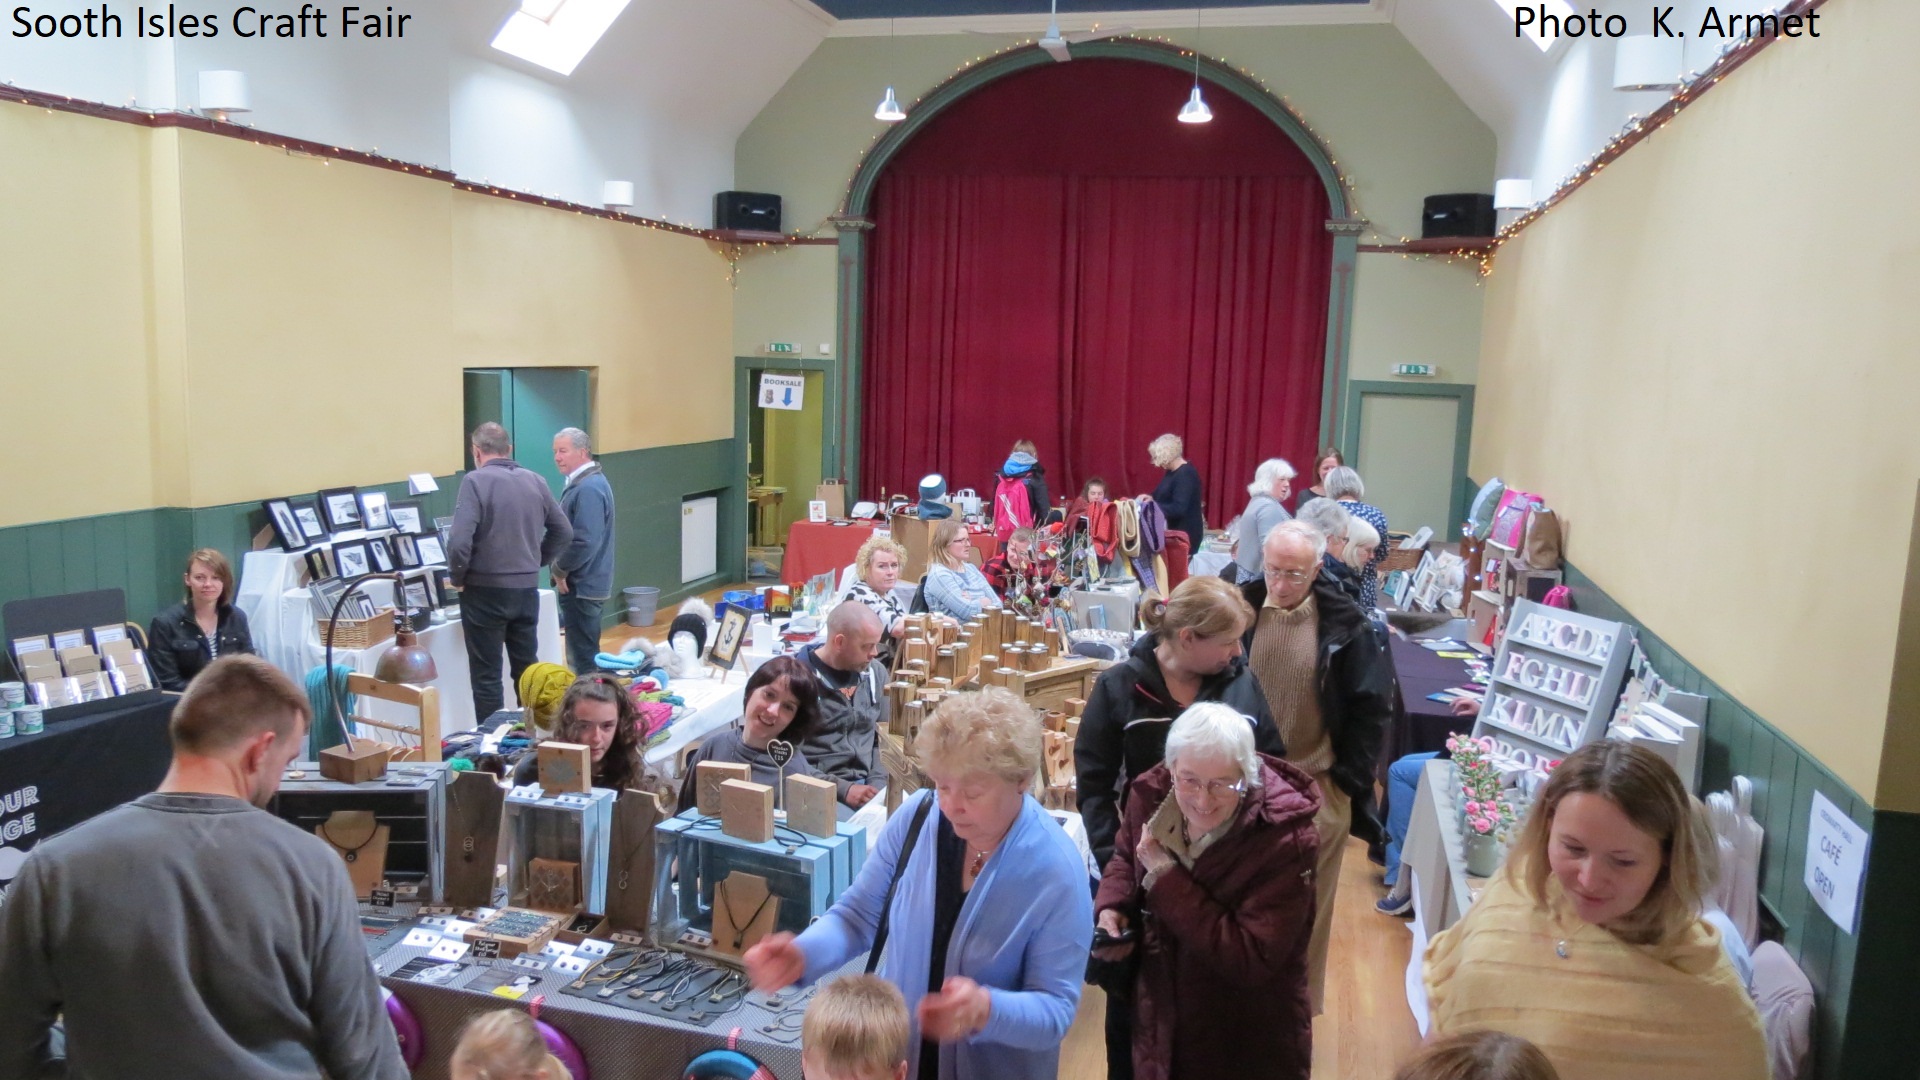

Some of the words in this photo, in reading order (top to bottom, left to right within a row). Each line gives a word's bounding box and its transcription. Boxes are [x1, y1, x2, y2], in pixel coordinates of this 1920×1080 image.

[764, 378, 802, 387] BOOKSALE
[1515, 612, 1613, 661] ABCDE
[1502, 651, 1599, 706] FGHIJ
[1487, 692, 1584, 750] KLMN
[0, 812, 36, 846] GE
[1820, 835, 1842, 866] CAFÉ
[1814, 866, 1836, 900] OPEN
